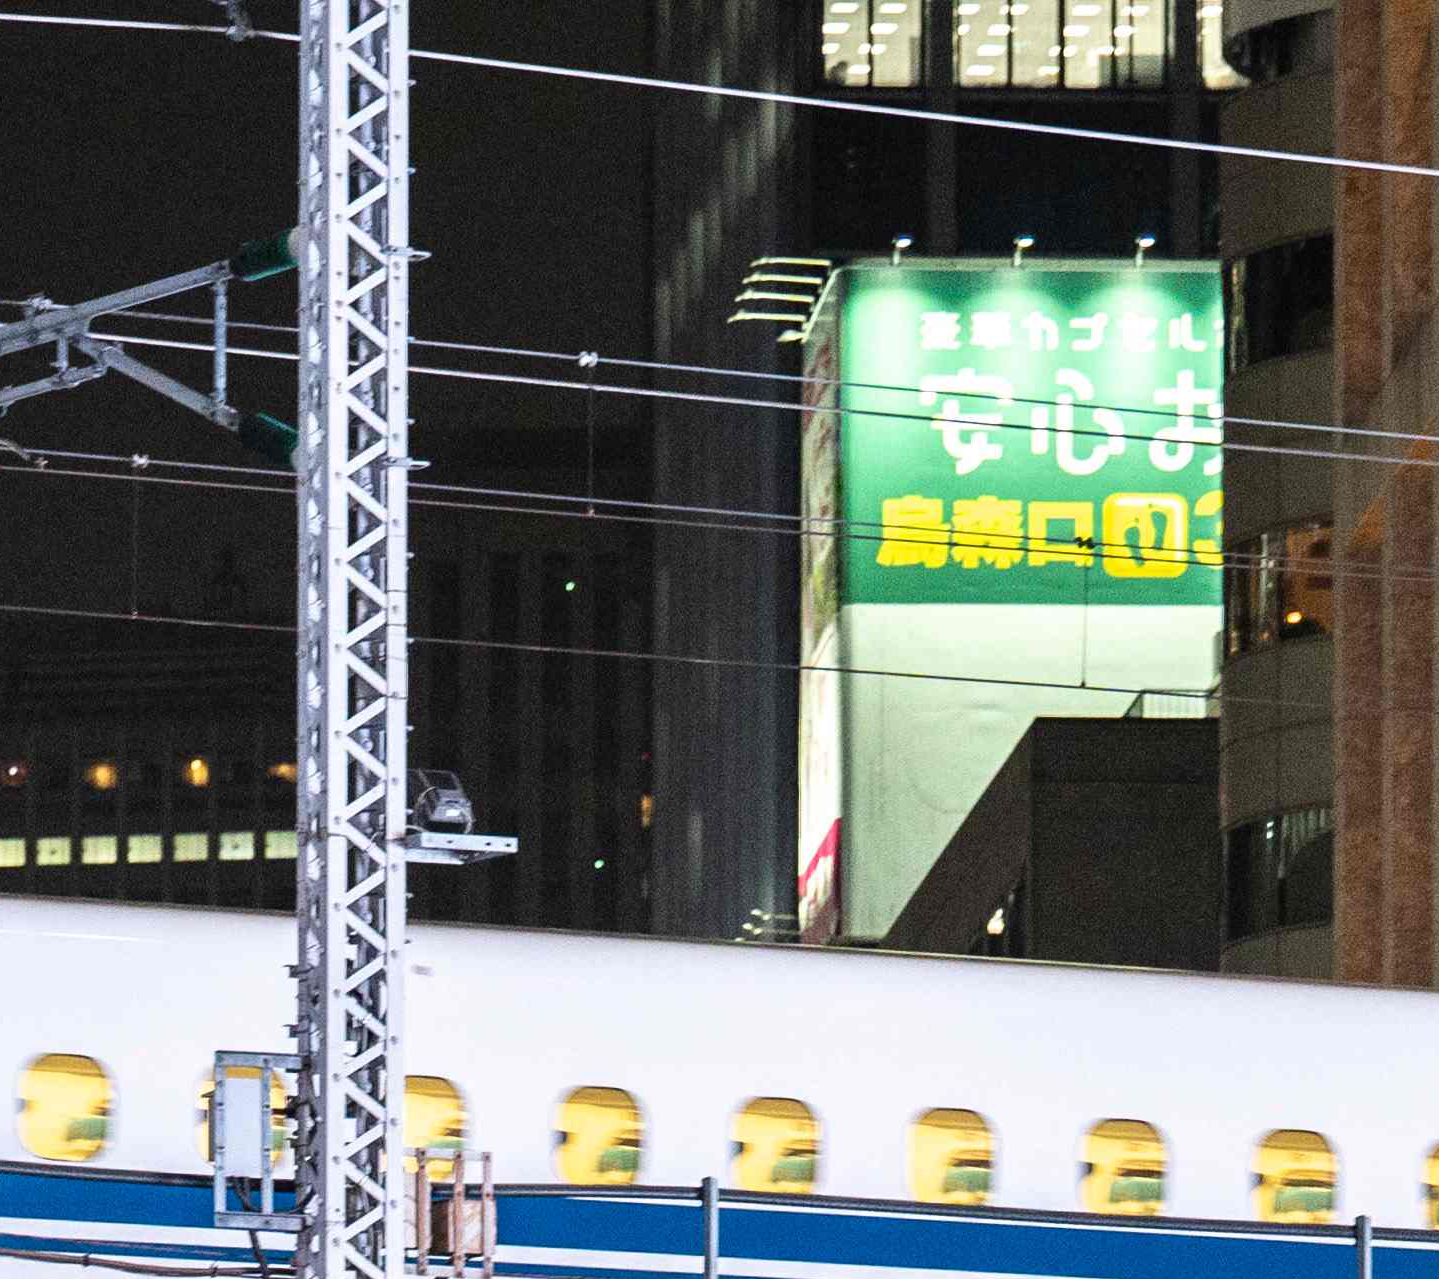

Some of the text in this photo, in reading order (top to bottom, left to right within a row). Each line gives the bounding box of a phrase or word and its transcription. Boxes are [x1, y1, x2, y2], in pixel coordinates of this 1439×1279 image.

[920, 311, 1223, 353] 豪華カプセル
